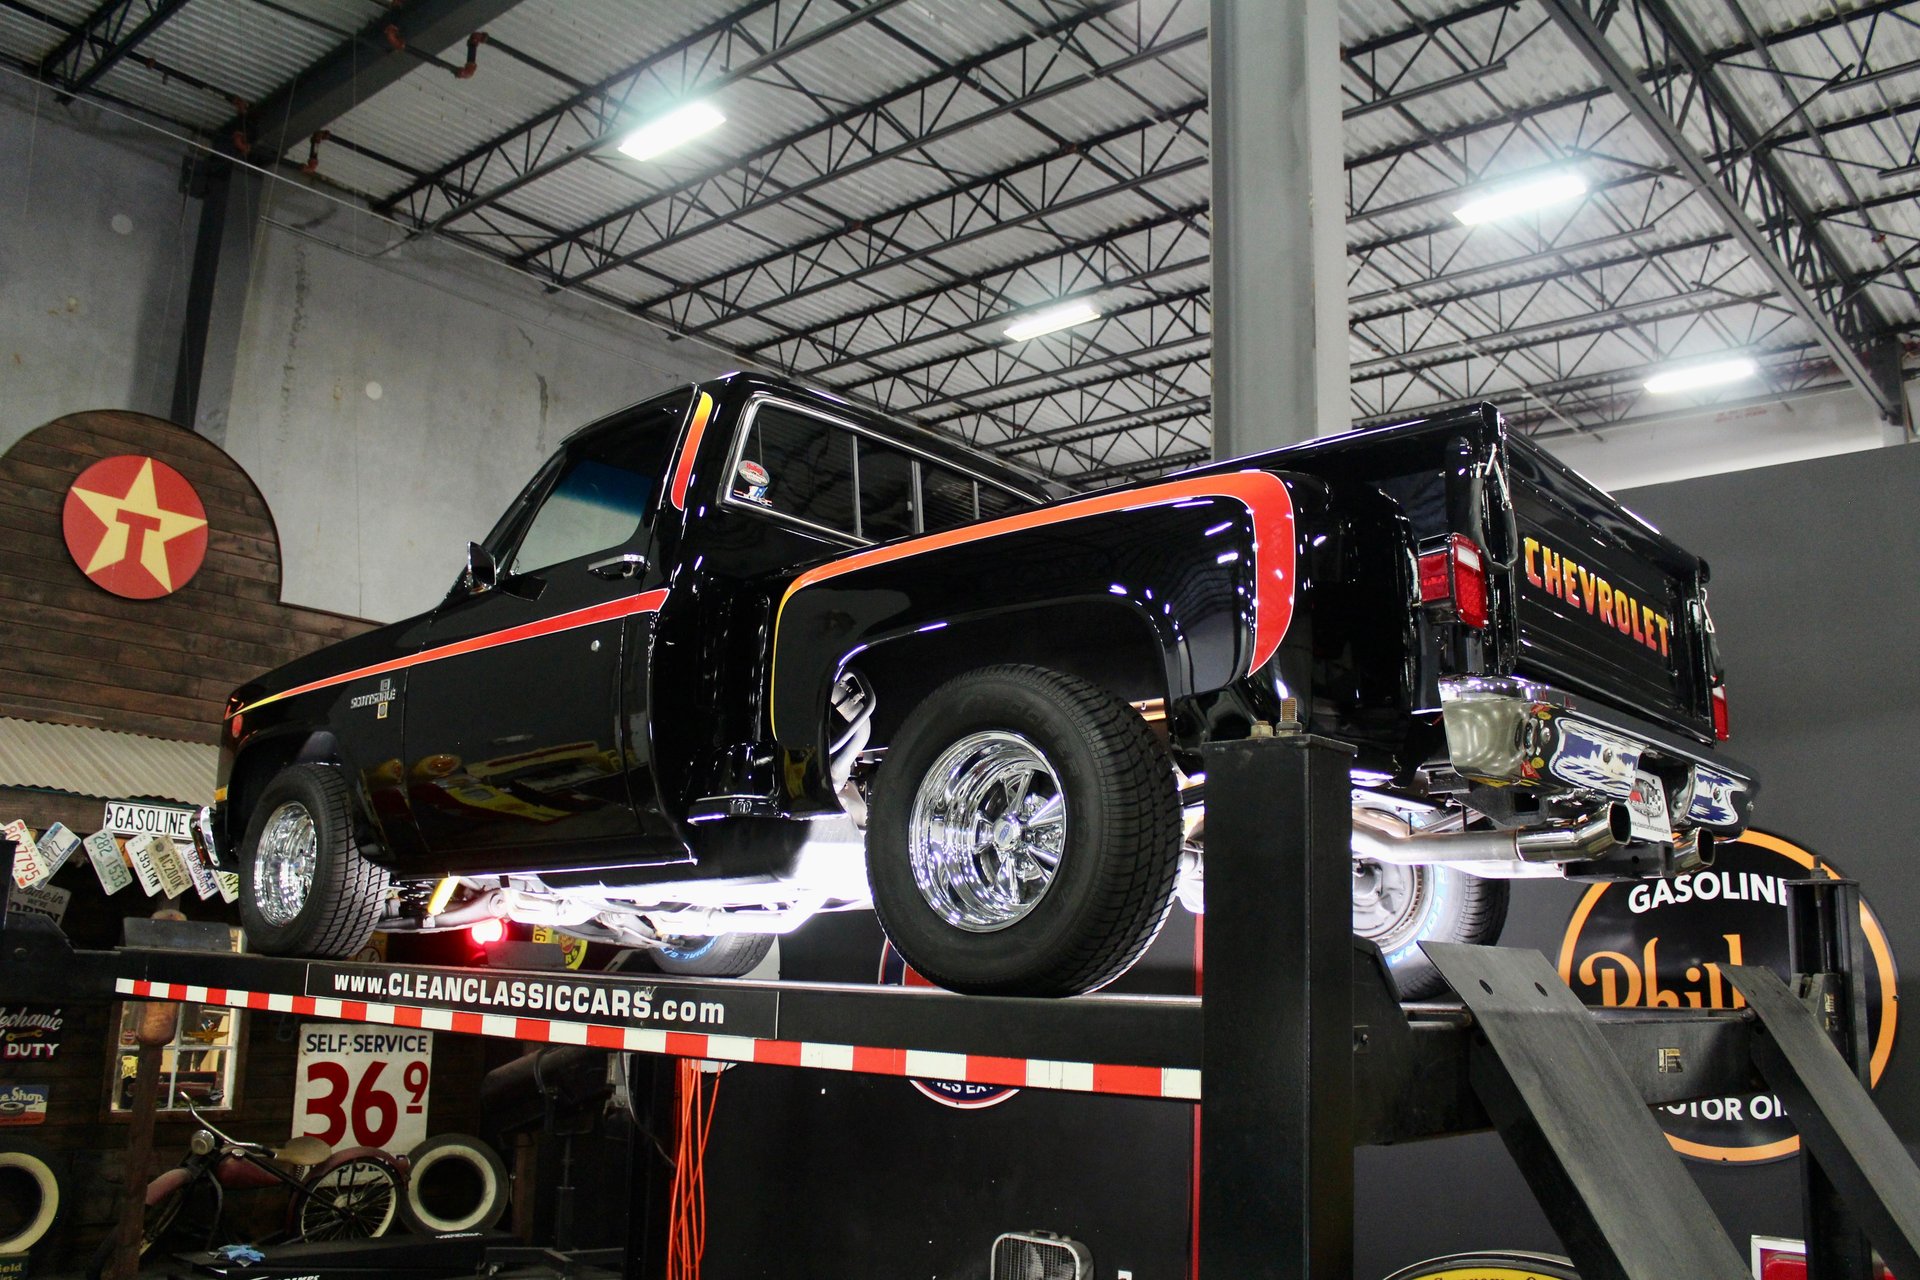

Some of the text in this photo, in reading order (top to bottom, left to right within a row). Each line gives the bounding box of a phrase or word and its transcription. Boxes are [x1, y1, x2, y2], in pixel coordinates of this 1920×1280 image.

[1524, 537, 1668, 657] CHEVROLET
[115, 806, 187, 835] GASOLINE
[94, 832, 127, 888] 282 1533
[334, 973, 725, 1025] www.CLEANCLASSICCARS.com
[7, 1043, 60, 1057] DUTY
[11, 1086, 45, 1105] Shop
[1750, 1094, 1789, 1120] OI
